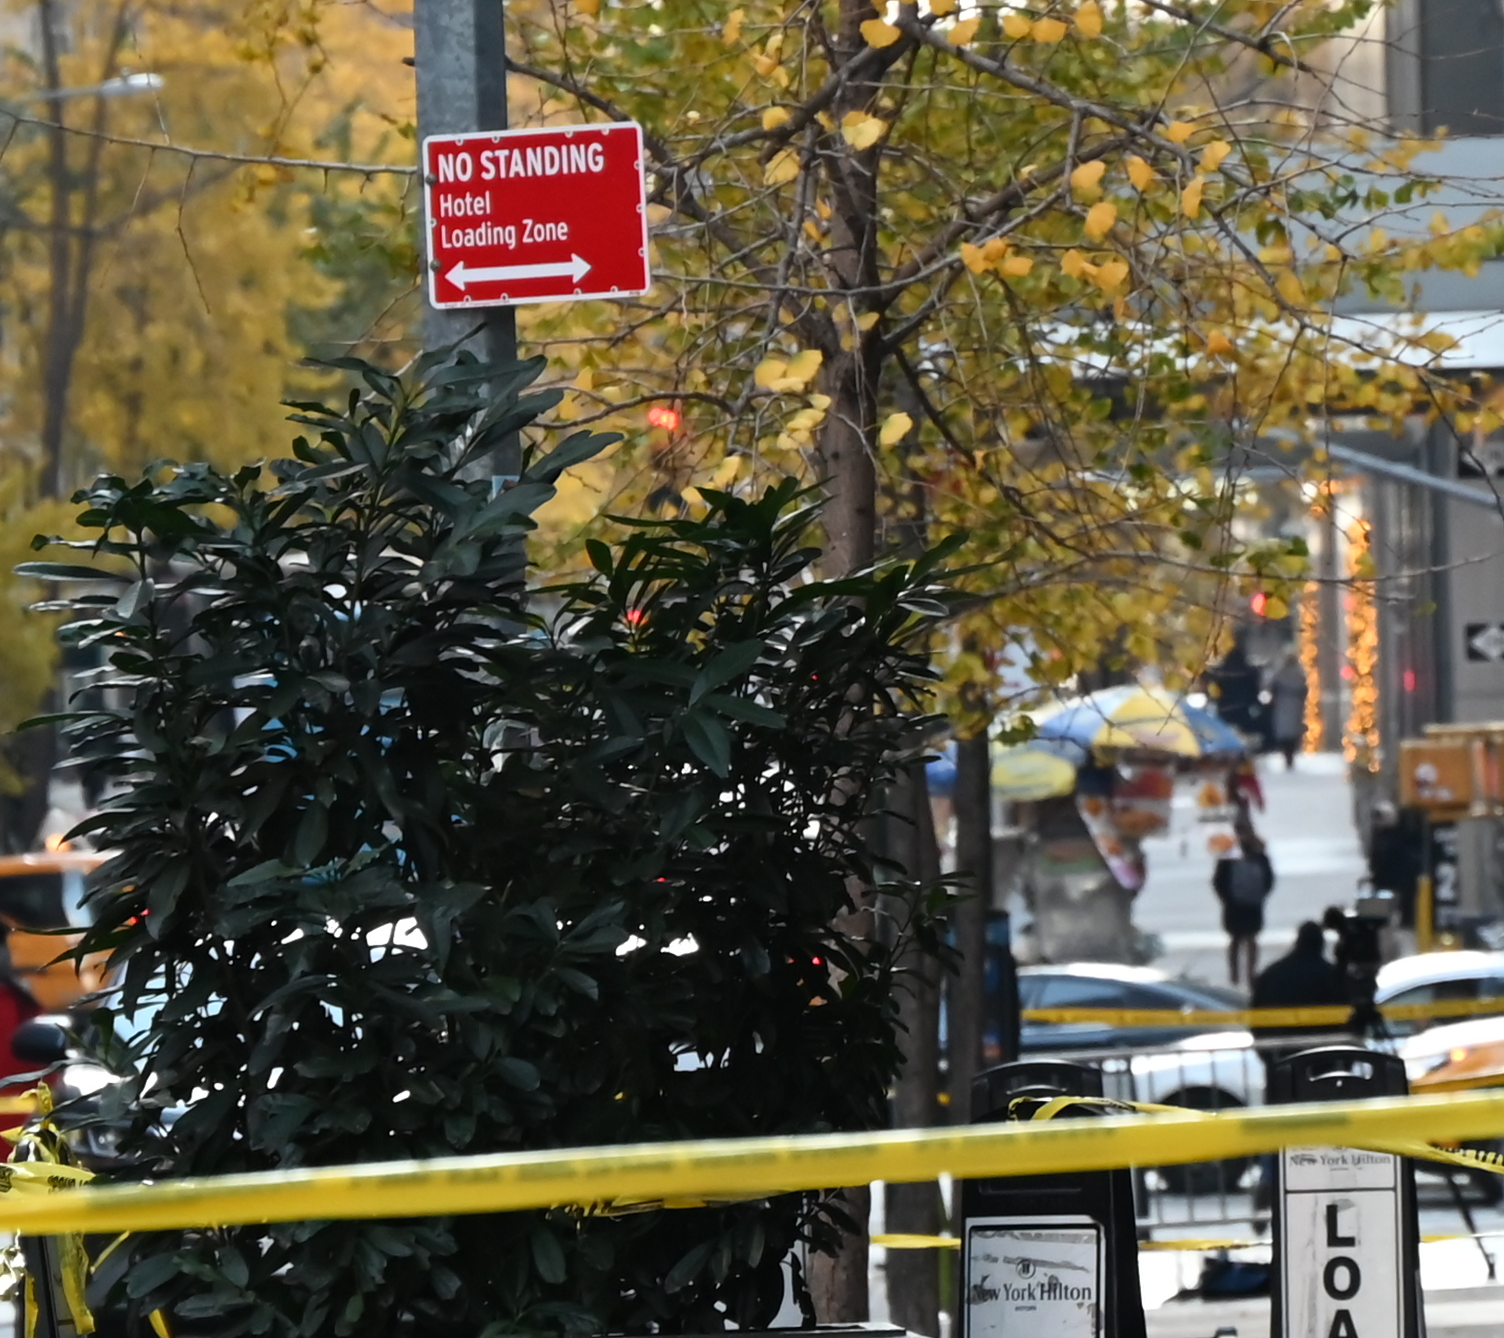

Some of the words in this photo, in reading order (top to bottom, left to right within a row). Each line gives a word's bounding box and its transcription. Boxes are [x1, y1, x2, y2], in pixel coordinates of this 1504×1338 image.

[437, 151, 473, 184] NO
[480, 141, 605, 181] STANDING
[439, 191, 491, 218] Hotel
[440, 220, 517, 251] Loading
[522, 218, 569, 244] Zone
[1320, 1154, 1348, 1166] York
[1003, 1282, 1036, 1302] York
[1040, 1281, 1092, 1301] Hilton
